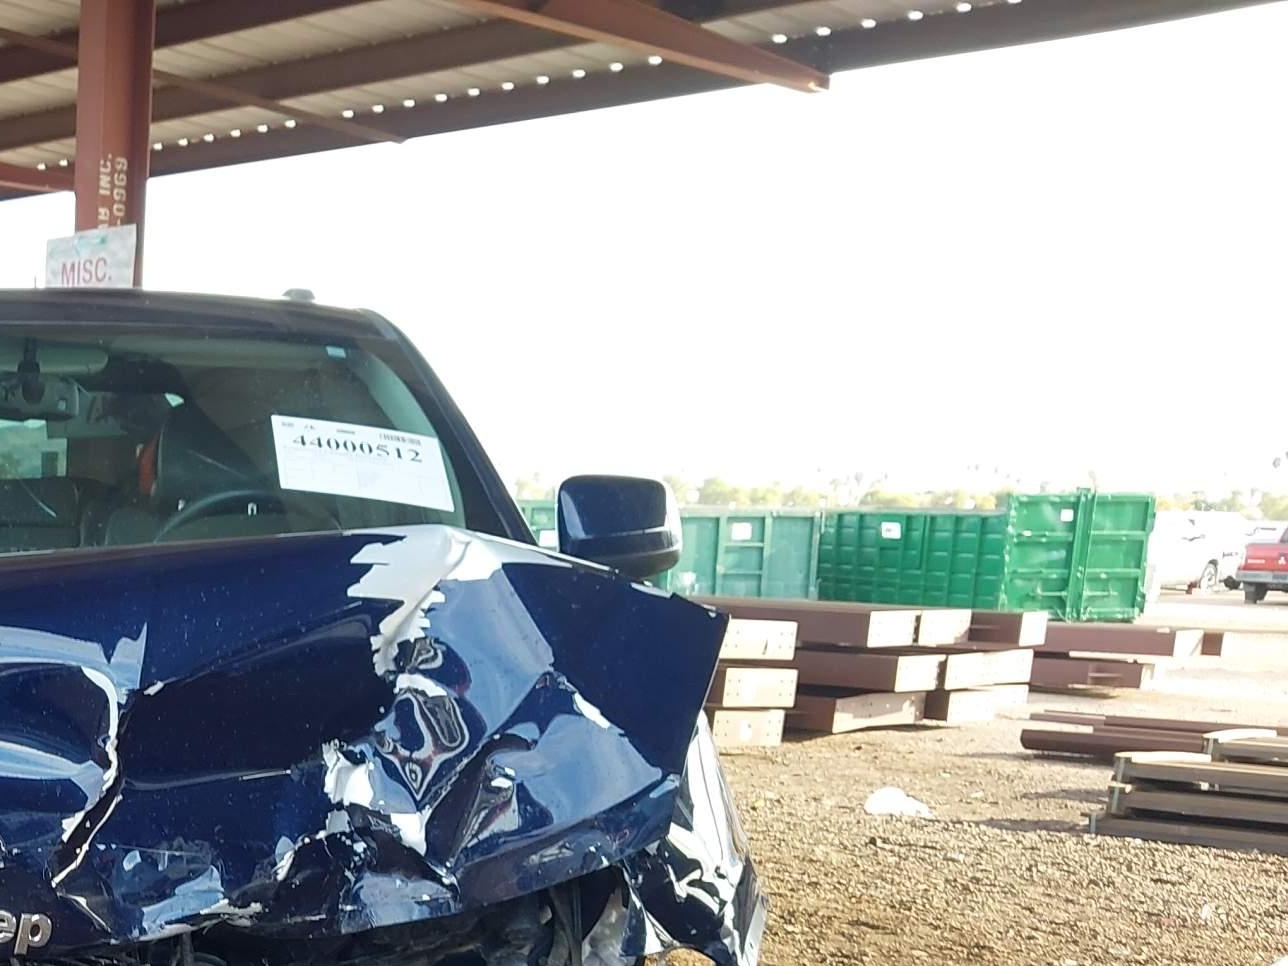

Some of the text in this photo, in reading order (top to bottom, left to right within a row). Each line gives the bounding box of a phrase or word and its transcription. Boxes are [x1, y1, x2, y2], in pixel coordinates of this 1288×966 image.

[99, 153, 112, 196] INC.
[61, 257, 112, 287] MISC.
[292, 434, 423, 463] 44000512
